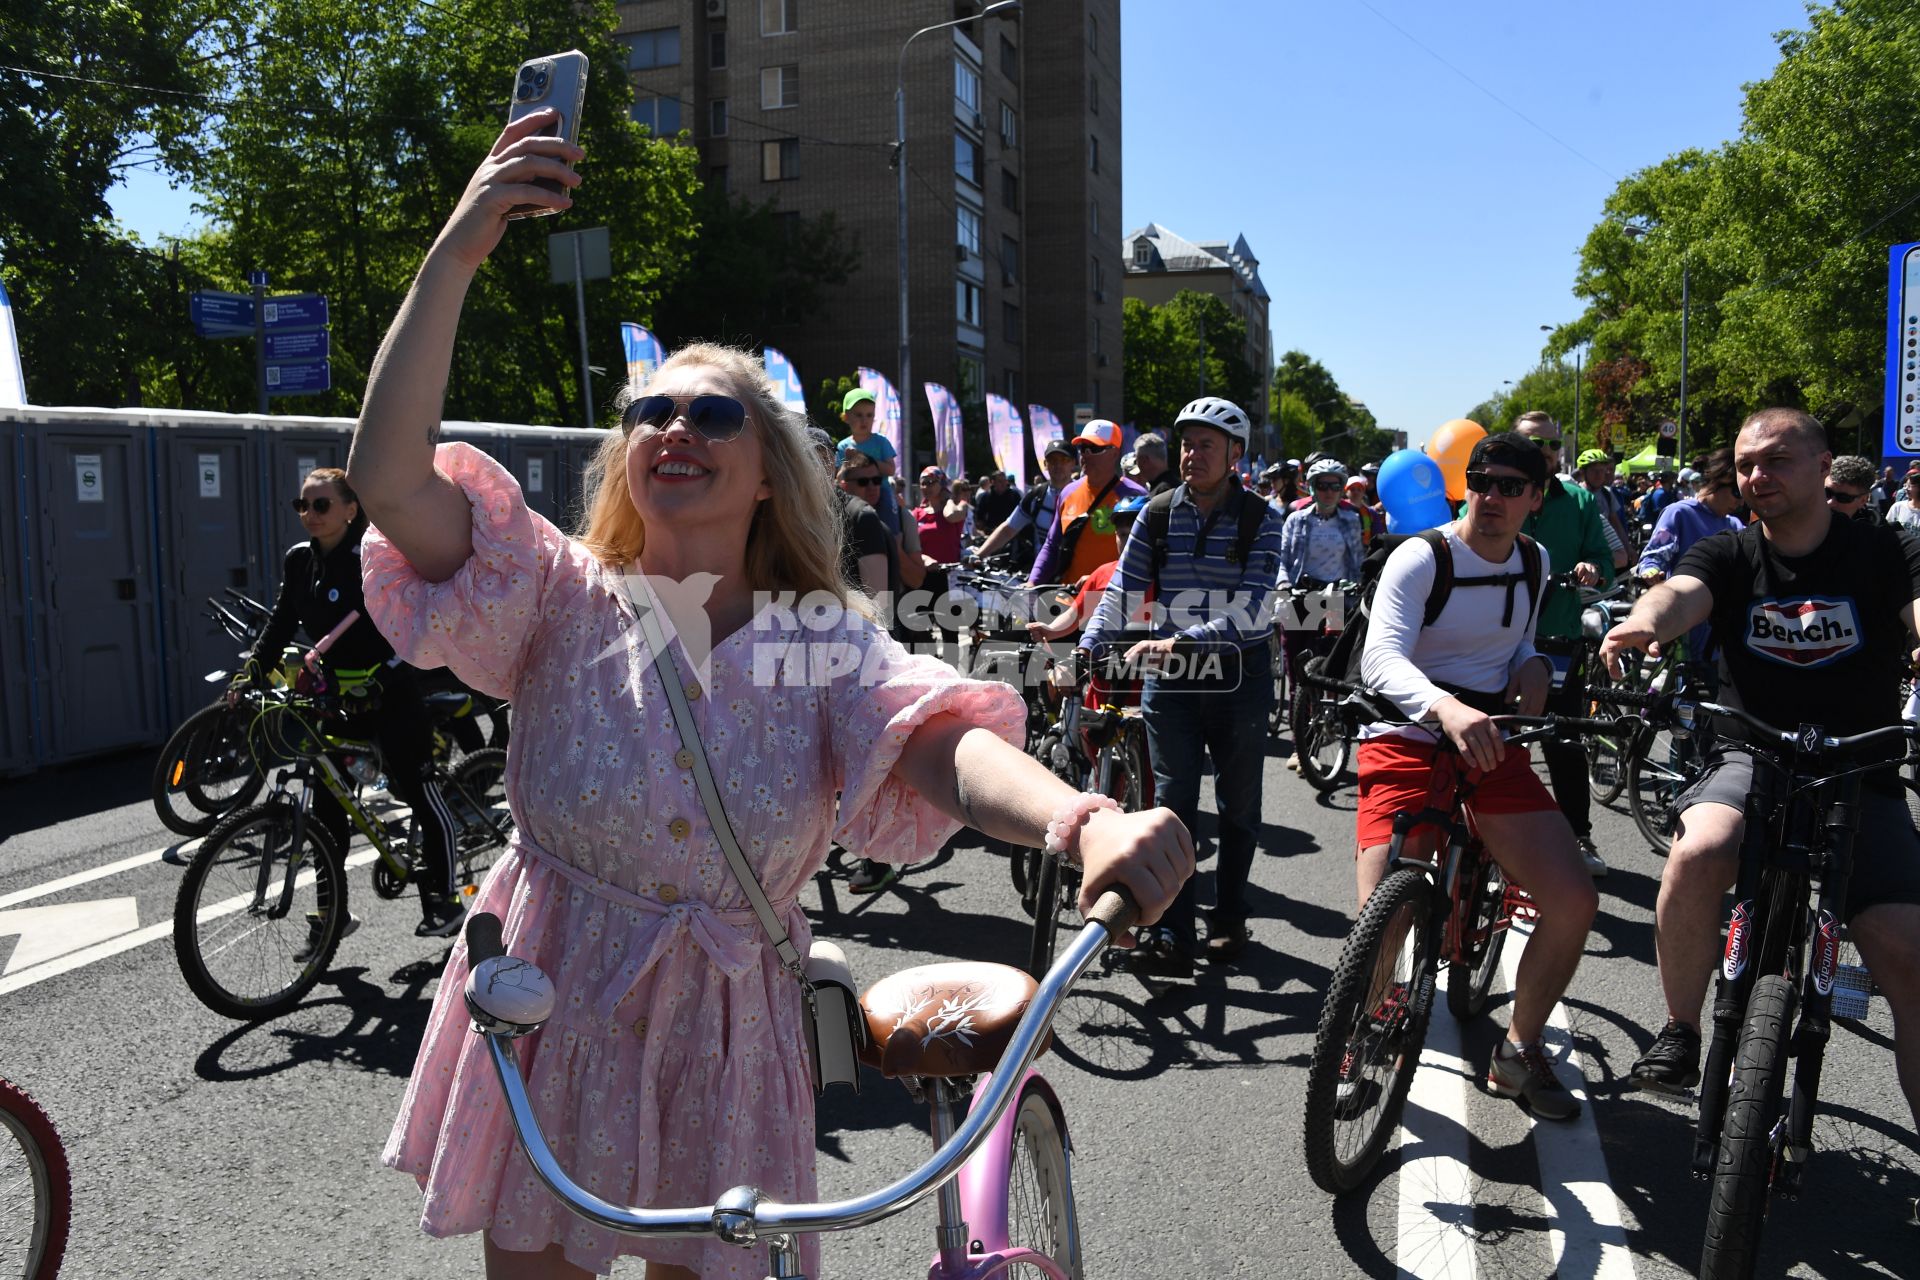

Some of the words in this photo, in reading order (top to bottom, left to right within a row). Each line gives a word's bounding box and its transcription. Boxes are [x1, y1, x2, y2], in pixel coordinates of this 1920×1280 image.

[1663, 425, 1674, 433] 40
[1752, 615, 1853, 643] Bench.
[1728, 928, 1743, 975] volcano
[1819, 942, 1834, 991] volcano
